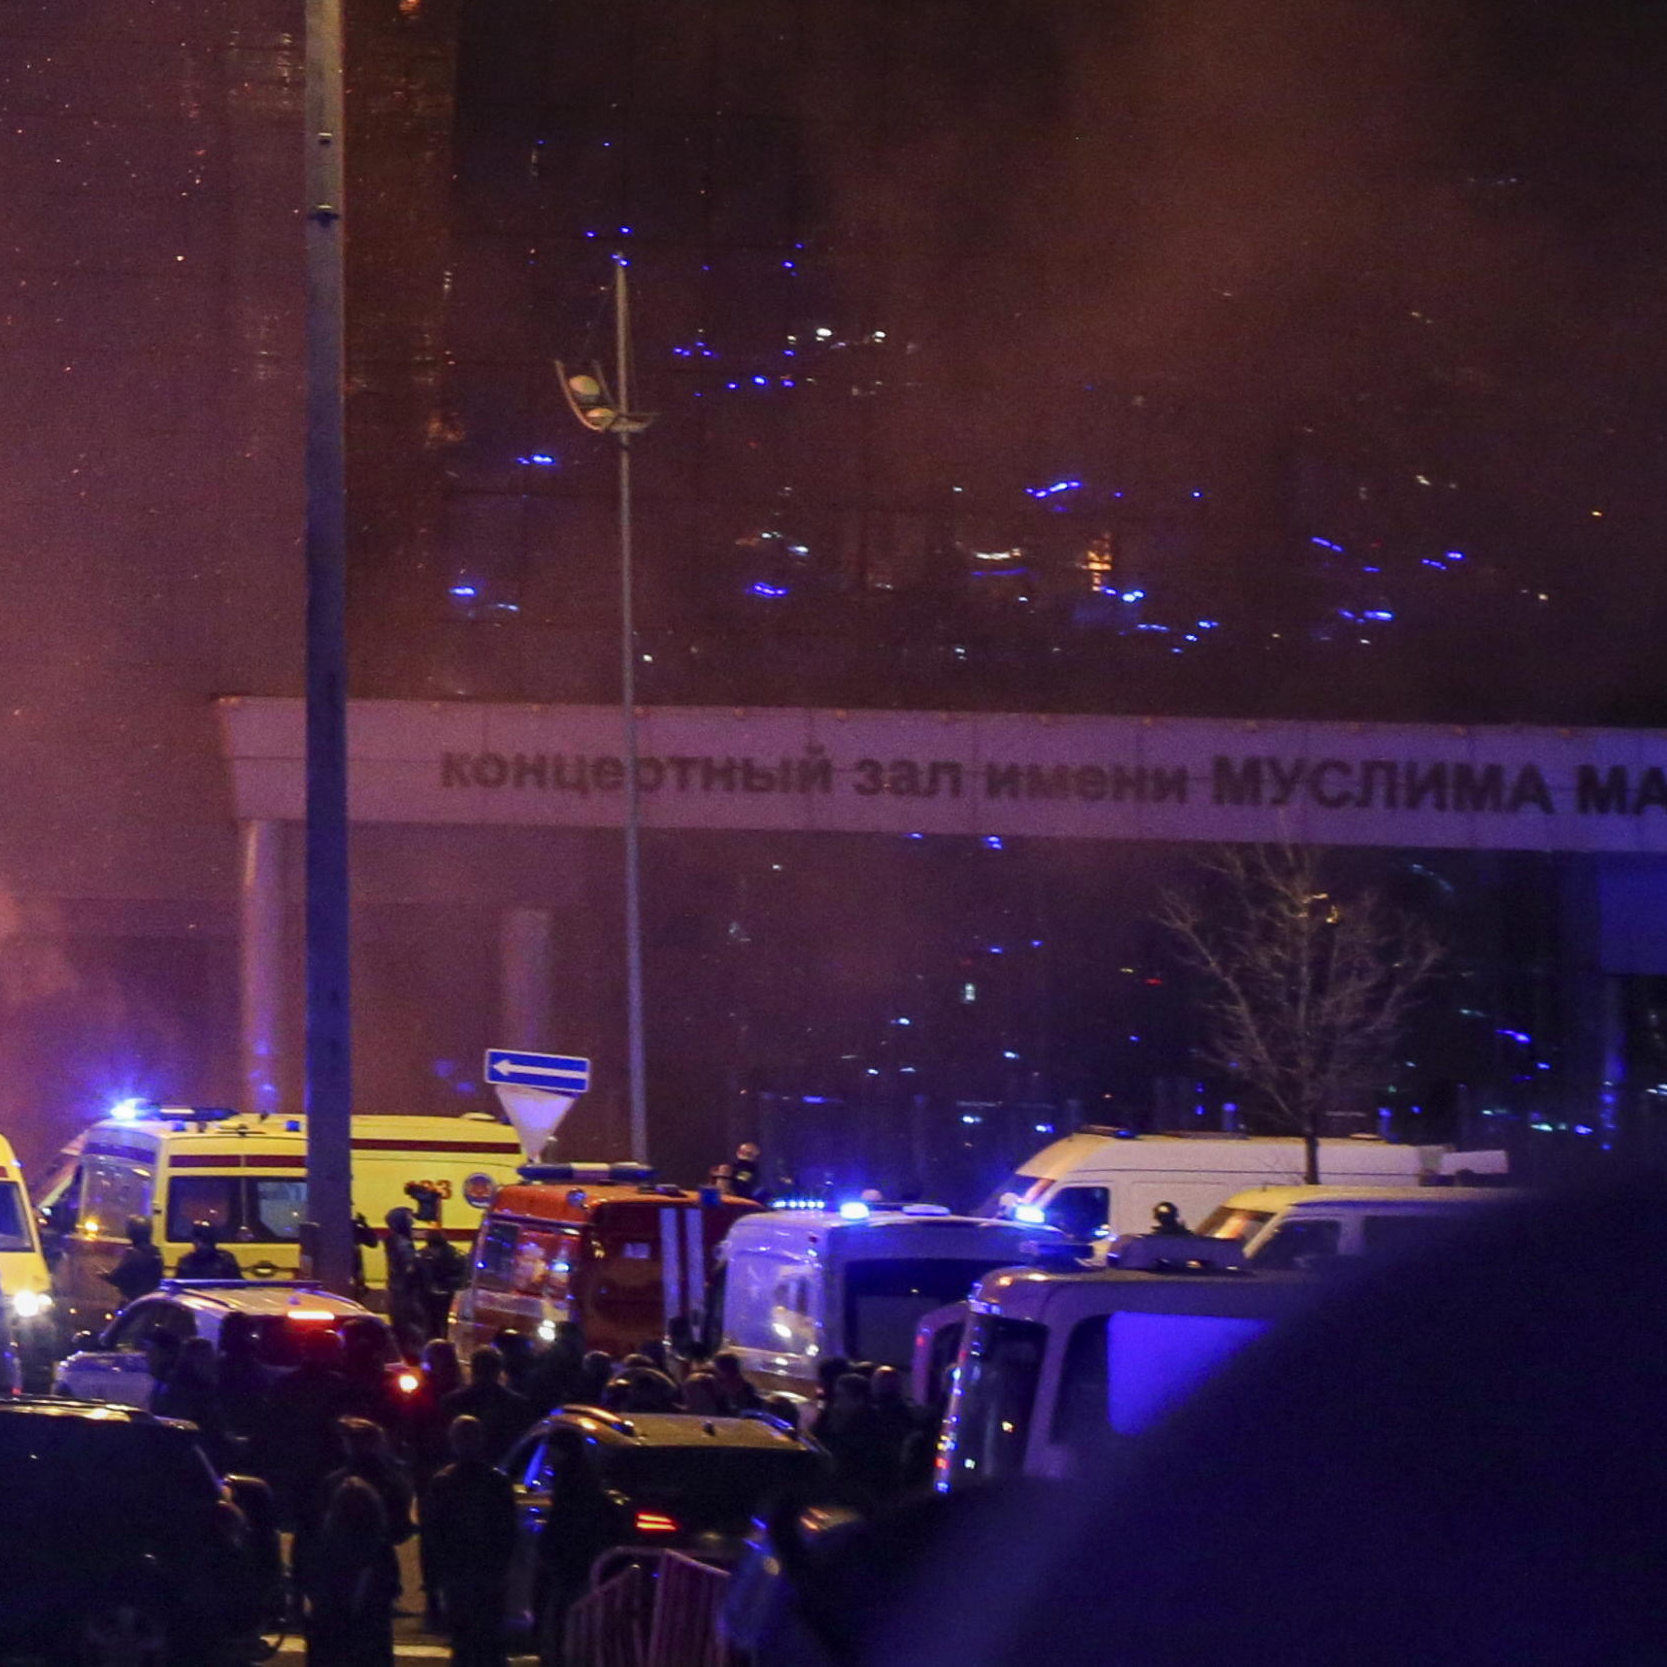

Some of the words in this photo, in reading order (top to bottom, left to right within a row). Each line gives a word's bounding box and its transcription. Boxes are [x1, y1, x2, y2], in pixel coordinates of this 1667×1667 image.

[440, 744, 835, 798] концертный
[853, 758, 962, 798] зал
[985, 762, 1189, 805] имени
[1211, 755, 1554, 814] МУСЛИМА
